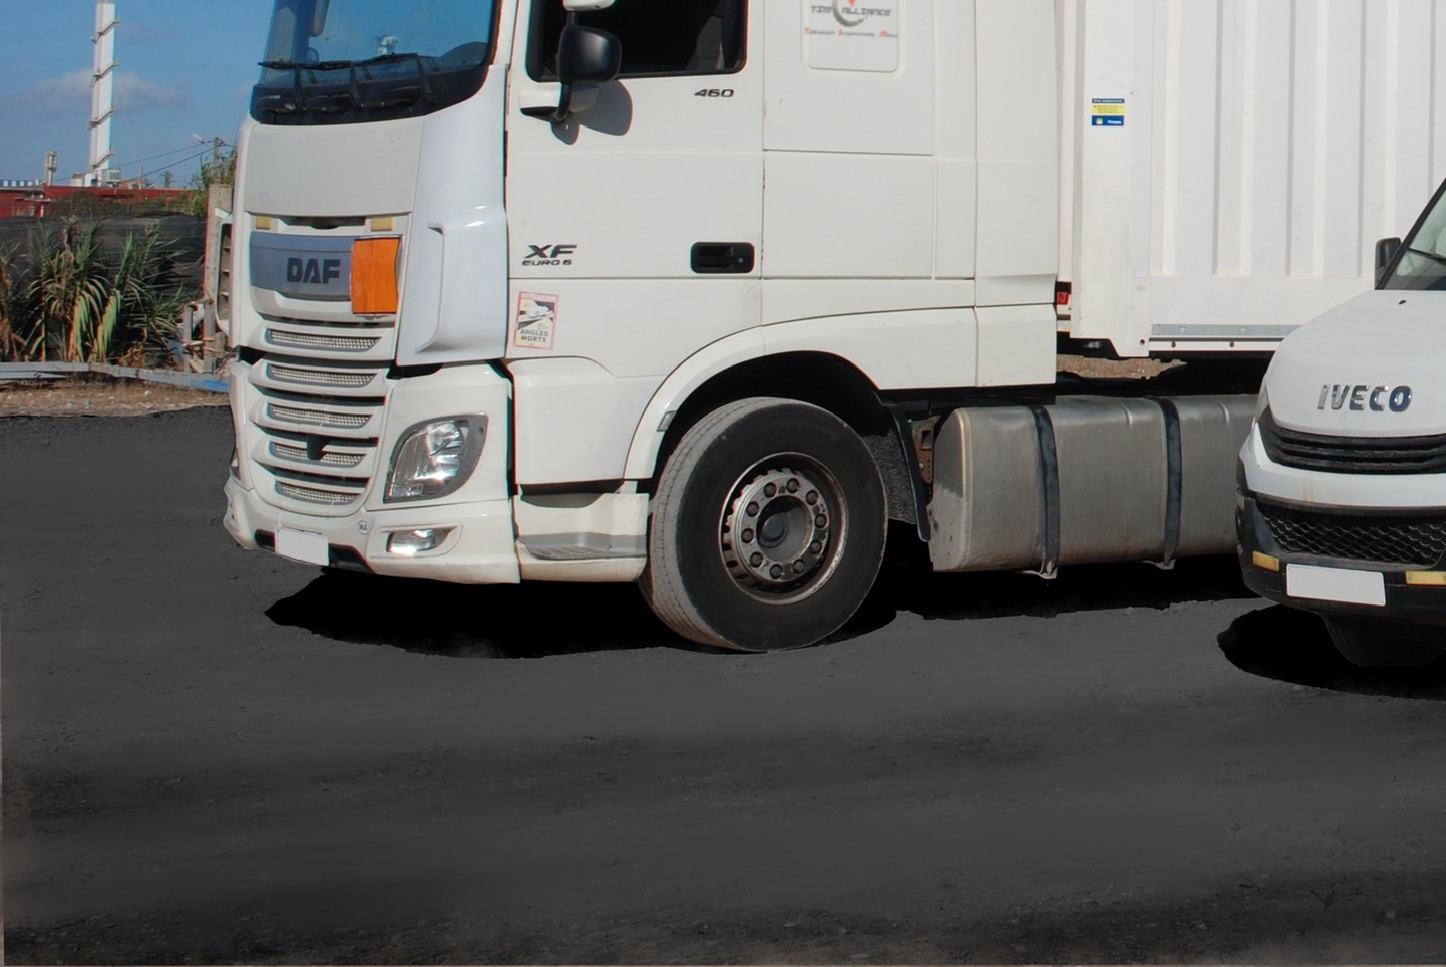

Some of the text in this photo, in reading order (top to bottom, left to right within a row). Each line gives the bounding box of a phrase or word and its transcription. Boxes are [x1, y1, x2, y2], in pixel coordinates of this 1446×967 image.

[811, 5, 891, 16] TIM ALLIANCE
[694, 88, 734, 98] 460
[524, 244, 578, 259] XF
[521, 258, 573, 267] EURO 6
[286, 257, 341, 284] DAF
[520, 328, 548, 337] ANGLES
[520, 335, 546, 343] MORTS
[1316, 383, 1412, 413] IVECO
